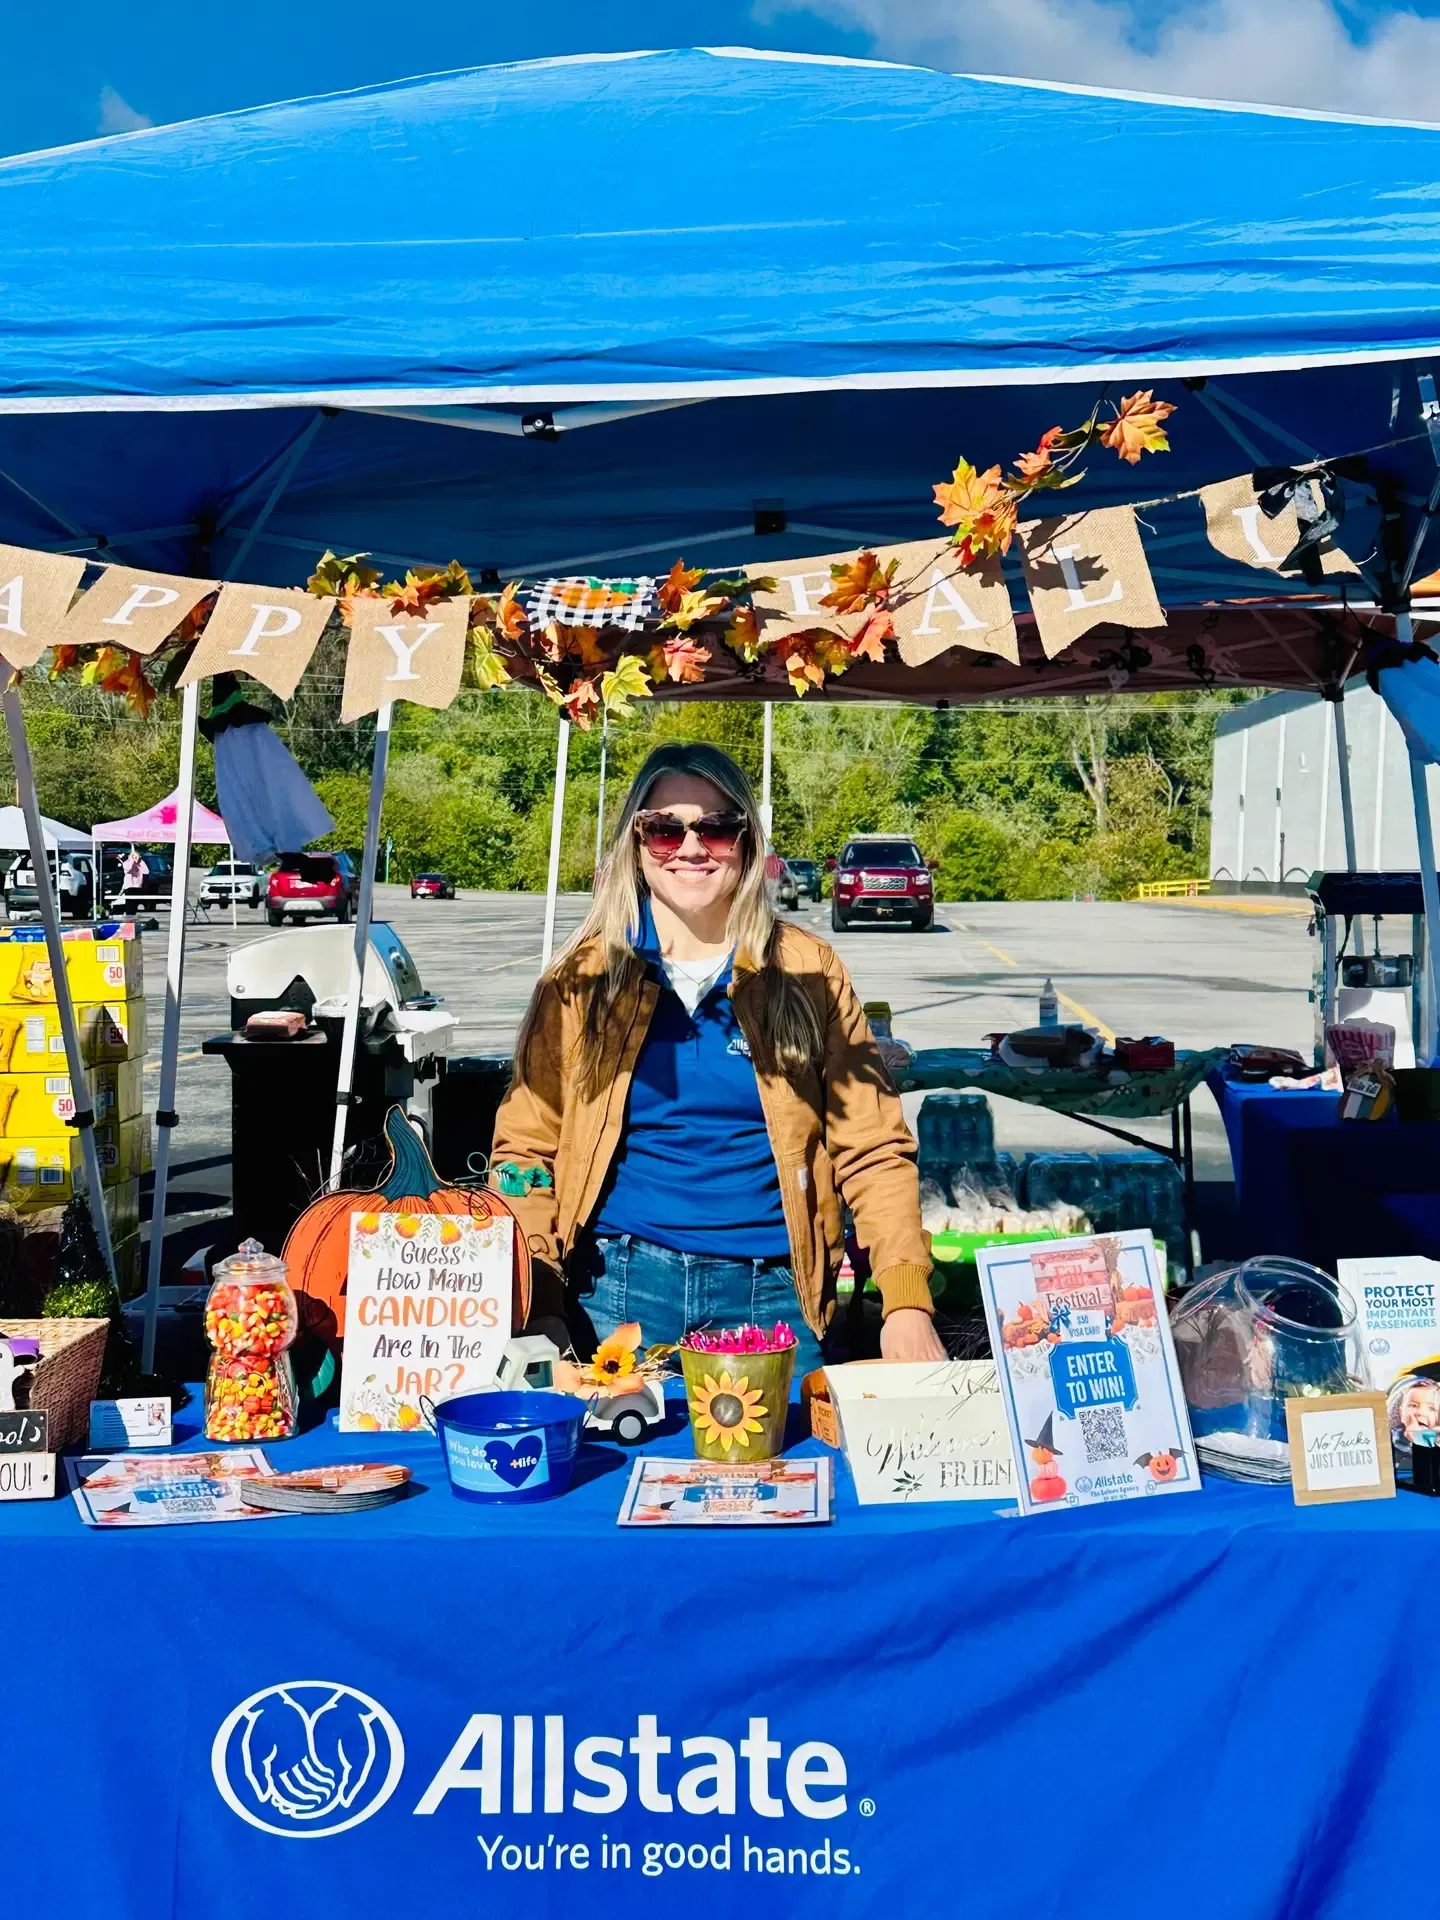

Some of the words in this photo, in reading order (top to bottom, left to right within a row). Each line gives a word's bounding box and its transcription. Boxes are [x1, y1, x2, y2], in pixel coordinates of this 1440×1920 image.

[0, 576, 444, 681] APPY
[109, 967, 122, 979] 50
[728, 1039, 750, 1050] Alls
[58, 1099, 73, 1112] 50
[401, 1241, 461, 1265] Guess
[376, 1268, 421, 1291] How
[428, 1268, 483, 1293] Many
[1364, 1284, 1436, 1299] PROTECT
[1046, 1288, 1102, 1309] Festival
[1365, 1298, 1399, 1309] YOUR
[1401, 1297, 1436, 1308] MOST
[1366, 1308, 1436, 1320] IMPORTANT
[1366, 1318, 1437, 1330] PASSENGERS
[372, 1334, 412, 1358] Are
[419, 1334, 440, 1358] In
[447, 1334, 482, 1359] The
[1066, 1350, 1118, 1378] ENTER
[1066, 1381, 1085, 1404] TO
[1088, 1375, 1127, 1401] WIN!
[448, 1440, 470, 1455] Who
[471, 1445, 487, 1458] do
[1307, 1433, 1330, 1453] No
[1331, 1431, 1371, 1448] Tricks
[450, 1454, 467, 1467] you
[467, 1457, 498, 1471] love?
[1310, 1453, 1336, 1470] JUST
[1337, 1448, 1373, 1468] TREATS
[0, 1461, 32, 1492] OU!
[940, 1458, 1012, 1488] FRIEN
[1094, 1473, 1134, 1489] Allstate
[413, 1713, 849, 1821] Allstate
[477, 1834, 590, 1872] You're
[600, 1834, 631, 1870] in
[641, 1834, 731, 1876] good
[743, 1836, 862, 1875] hands.
